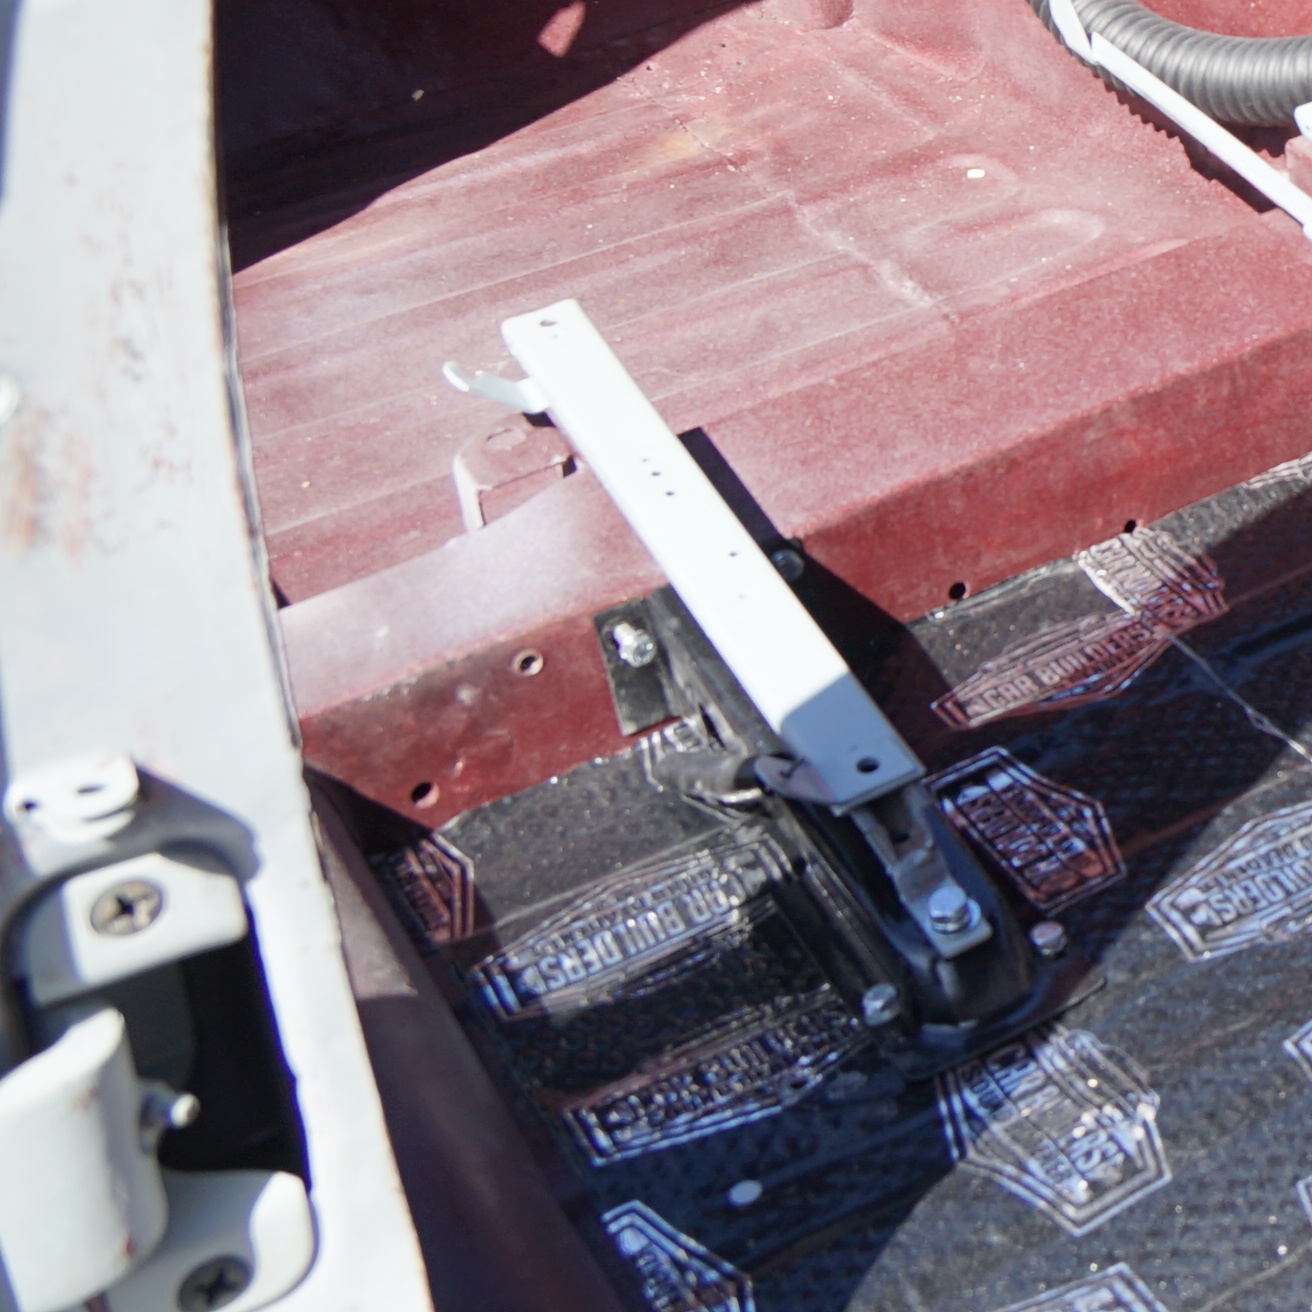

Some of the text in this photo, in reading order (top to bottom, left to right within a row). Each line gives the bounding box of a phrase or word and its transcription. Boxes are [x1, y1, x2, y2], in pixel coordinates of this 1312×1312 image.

[983, 621, 1154, 710] CAR BUILDERS
[536, 901, 687, 989] BUILDERS
